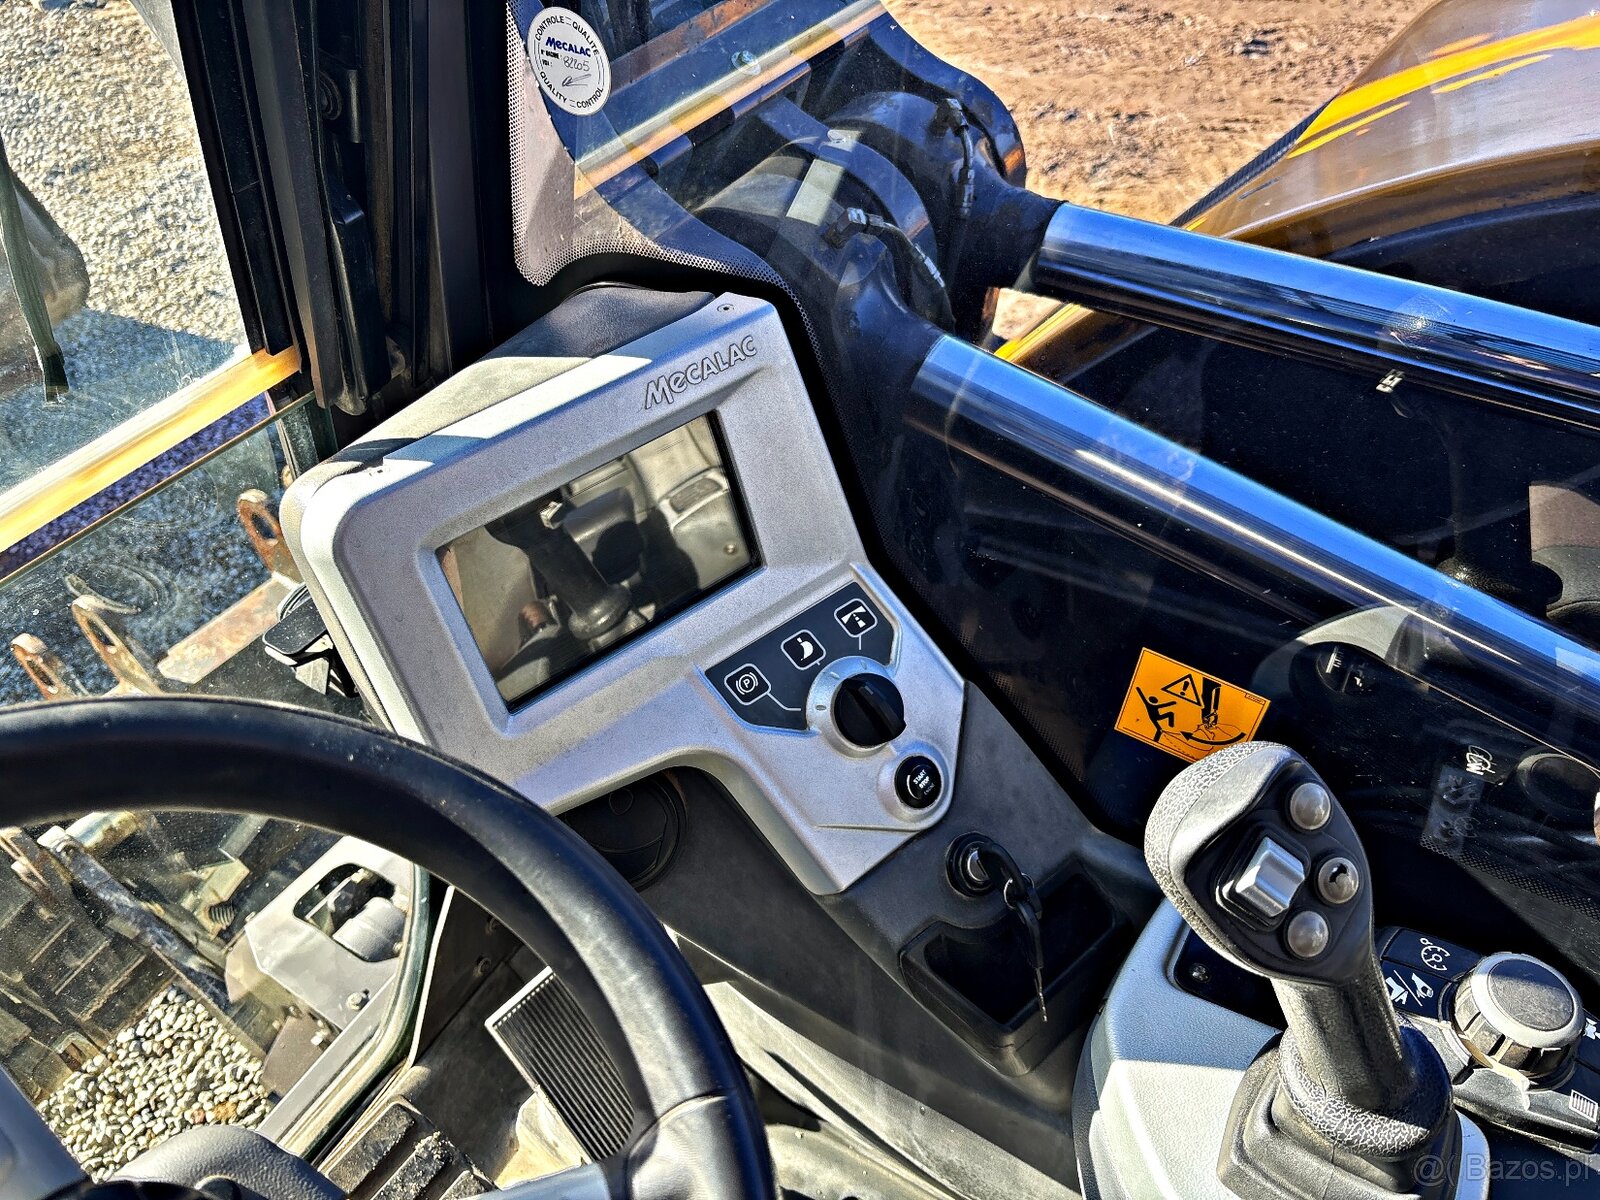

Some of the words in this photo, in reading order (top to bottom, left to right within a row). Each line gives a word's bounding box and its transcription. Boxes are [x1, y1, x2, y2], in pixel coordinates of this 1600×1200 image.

[535, 15, 565, 41] CONTROLE
[572, 21, 600, 56] QUALITE
[540, 72, 568, 104] QUALITY
[576, 87, 604, 109] CONTROL
[913, 769, 927, 785] START
[919, 776, 930, 789] STOP
